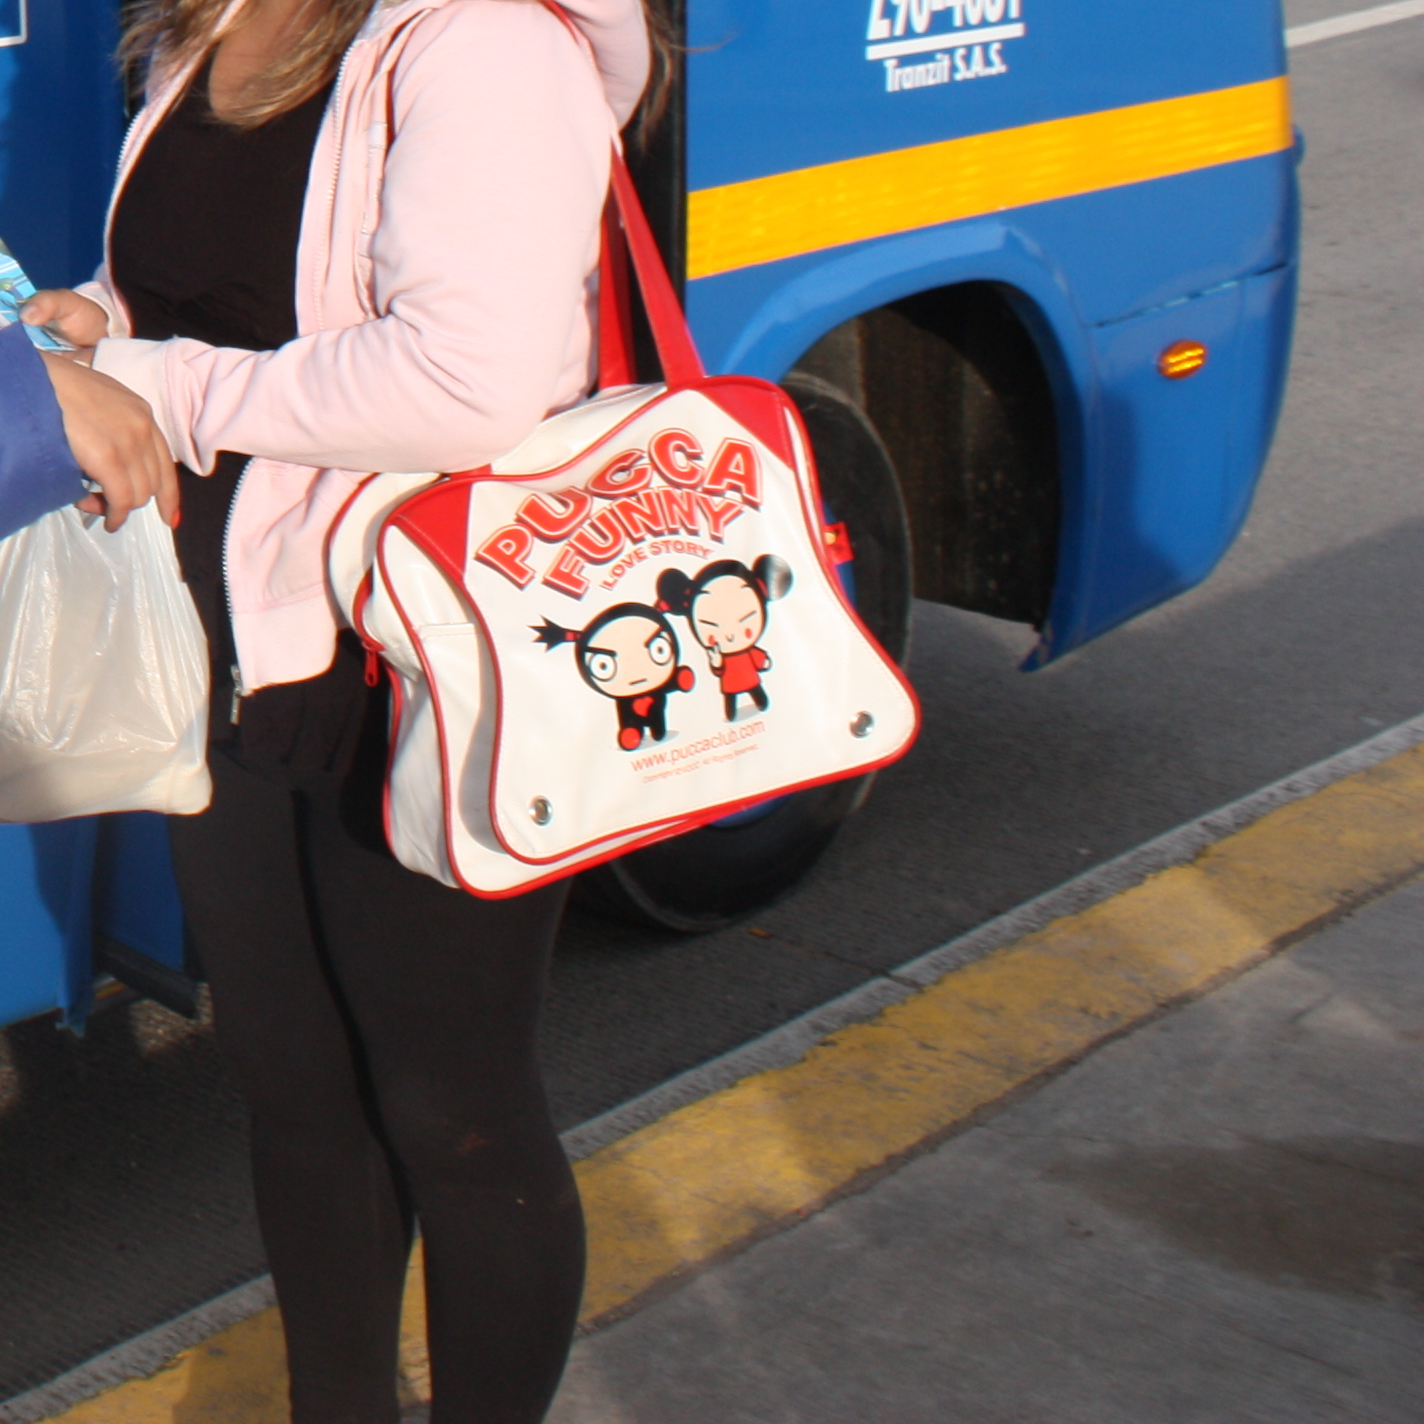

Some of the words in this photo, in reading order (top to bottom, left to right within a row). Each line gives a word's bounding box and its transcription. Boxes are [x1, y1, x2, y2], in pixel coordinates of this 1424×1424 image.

[882, 53, 951, 93] Tranzit
[472, 426, 765, 592] PUCCA
[540, 486, 745, 602] FUNNY
[599, 547, 649, 591] LOVE
[650, 538, 716, 560] STORY
[629, 719, 767, 772] www.puccaclub.com
